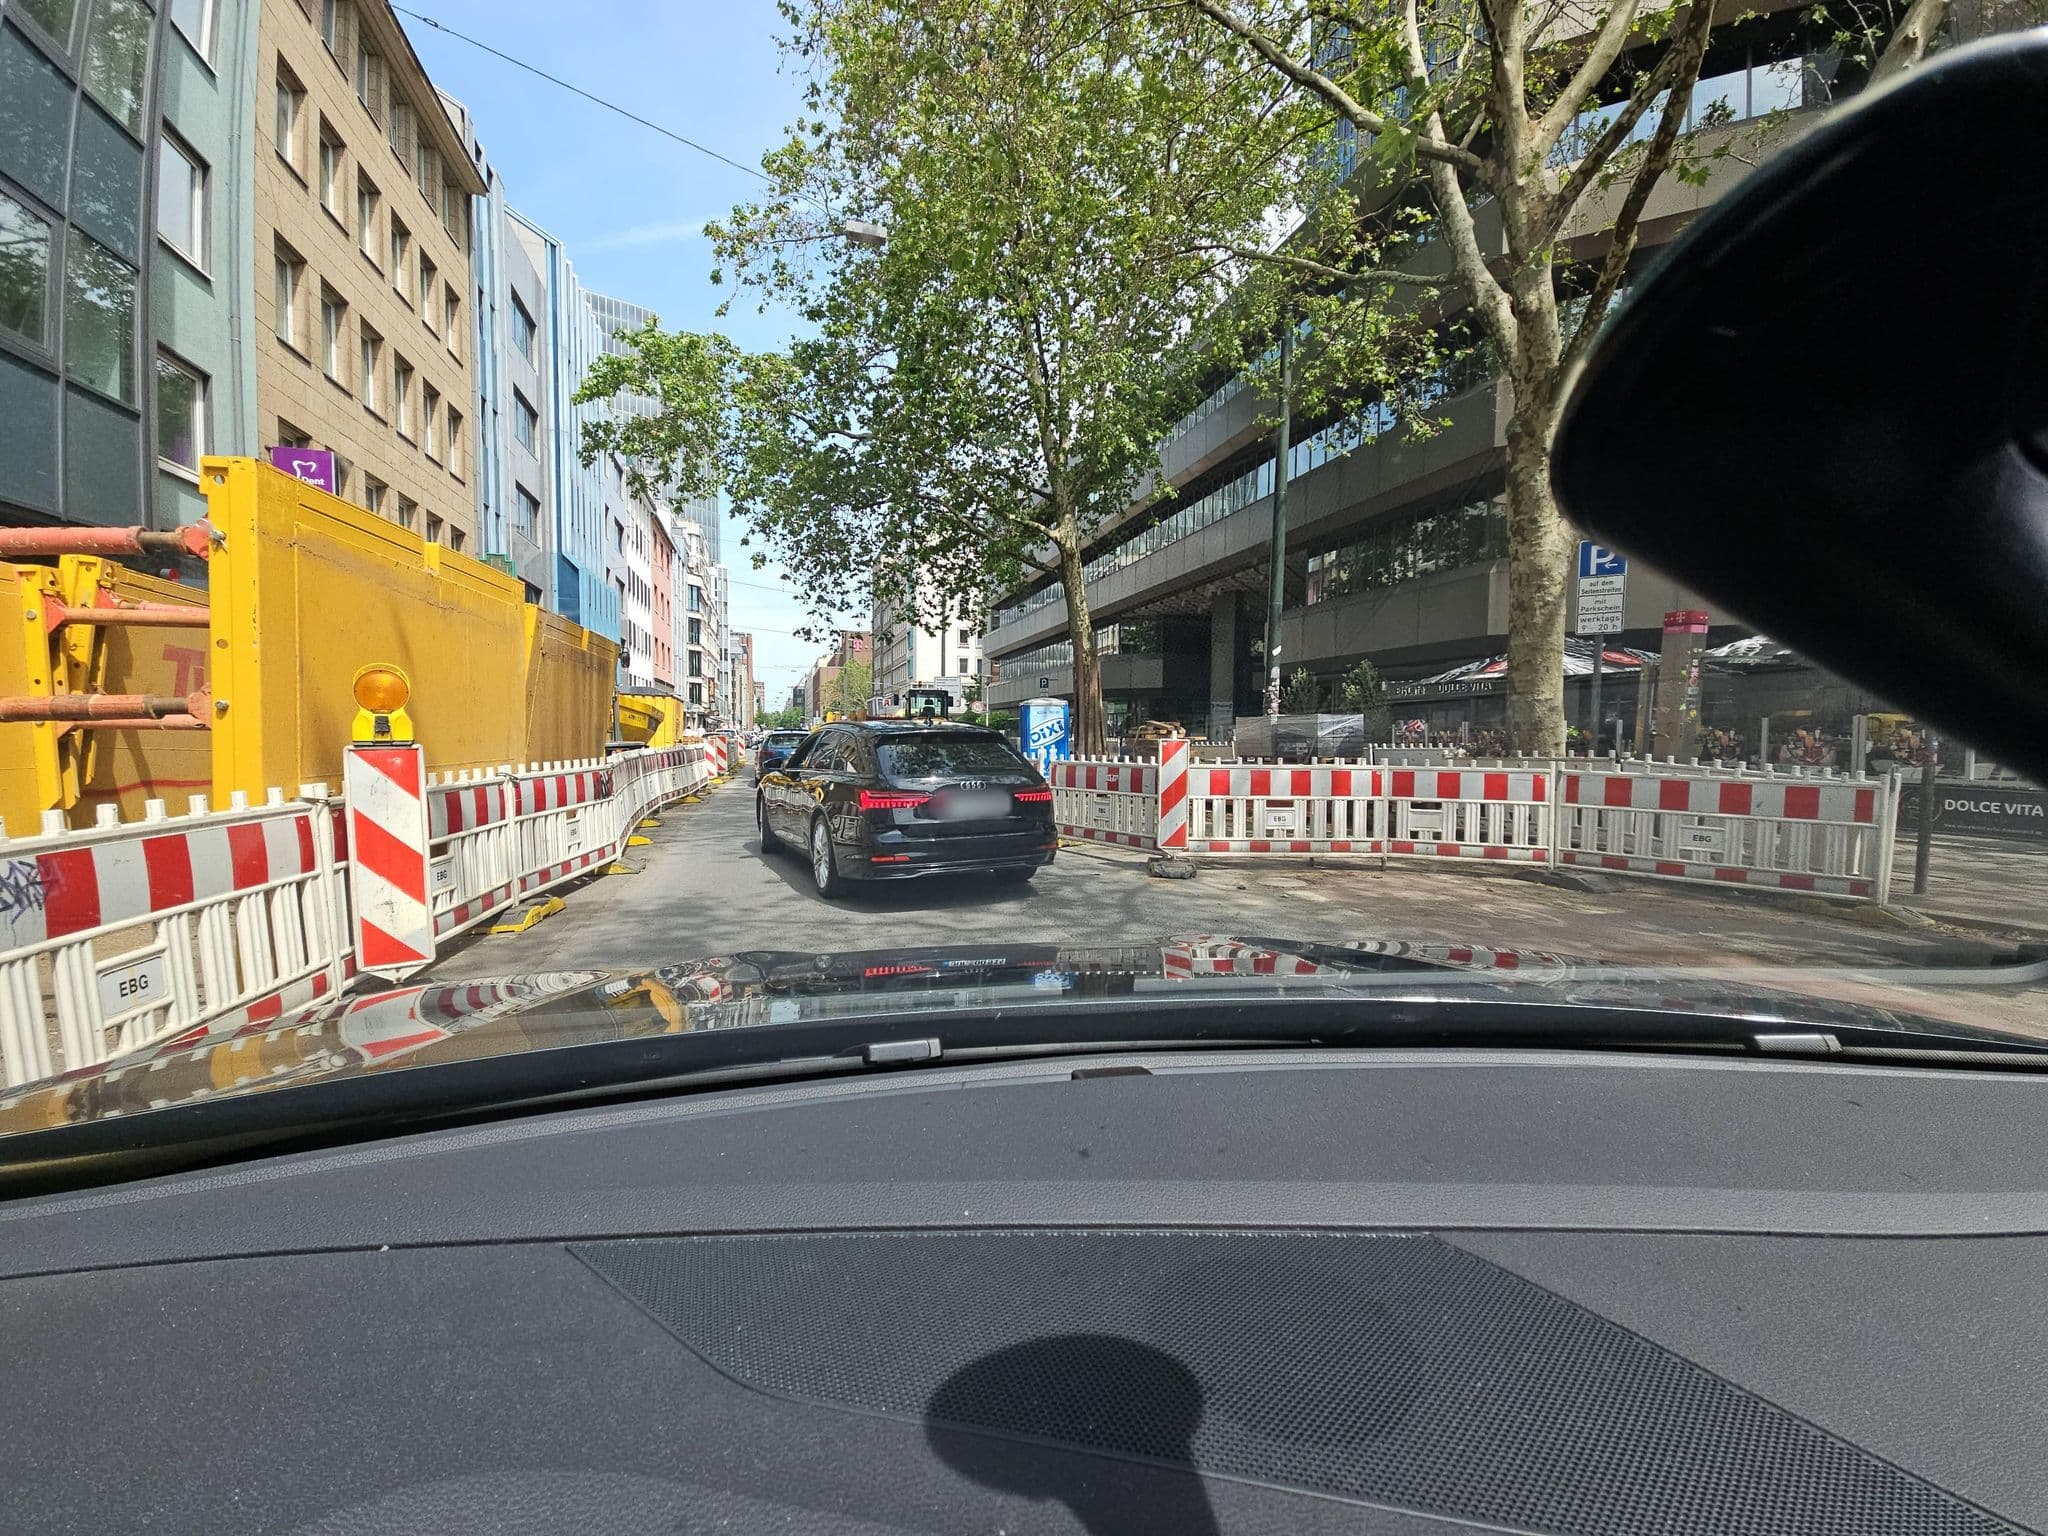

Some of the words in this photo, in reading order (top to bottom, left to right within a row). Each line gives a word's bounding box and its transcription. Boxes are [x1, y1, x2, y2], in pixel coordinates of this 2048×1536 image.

[1590, 545, 1616, 575] P
[1581, 587, 1622, 595] Seitenstreifen
[1580, 604, 1620, 612] Parkschein
[1598, 623, 1608, 631] 20
[1944, 799, 2001, 814] DOLCE
[2004, 803, 2044, 817] VITA
[1692, 834, 1712, 843] EBG
[436, 869, 448, 881] EBG
[119, 974, 149, 998] EBG
